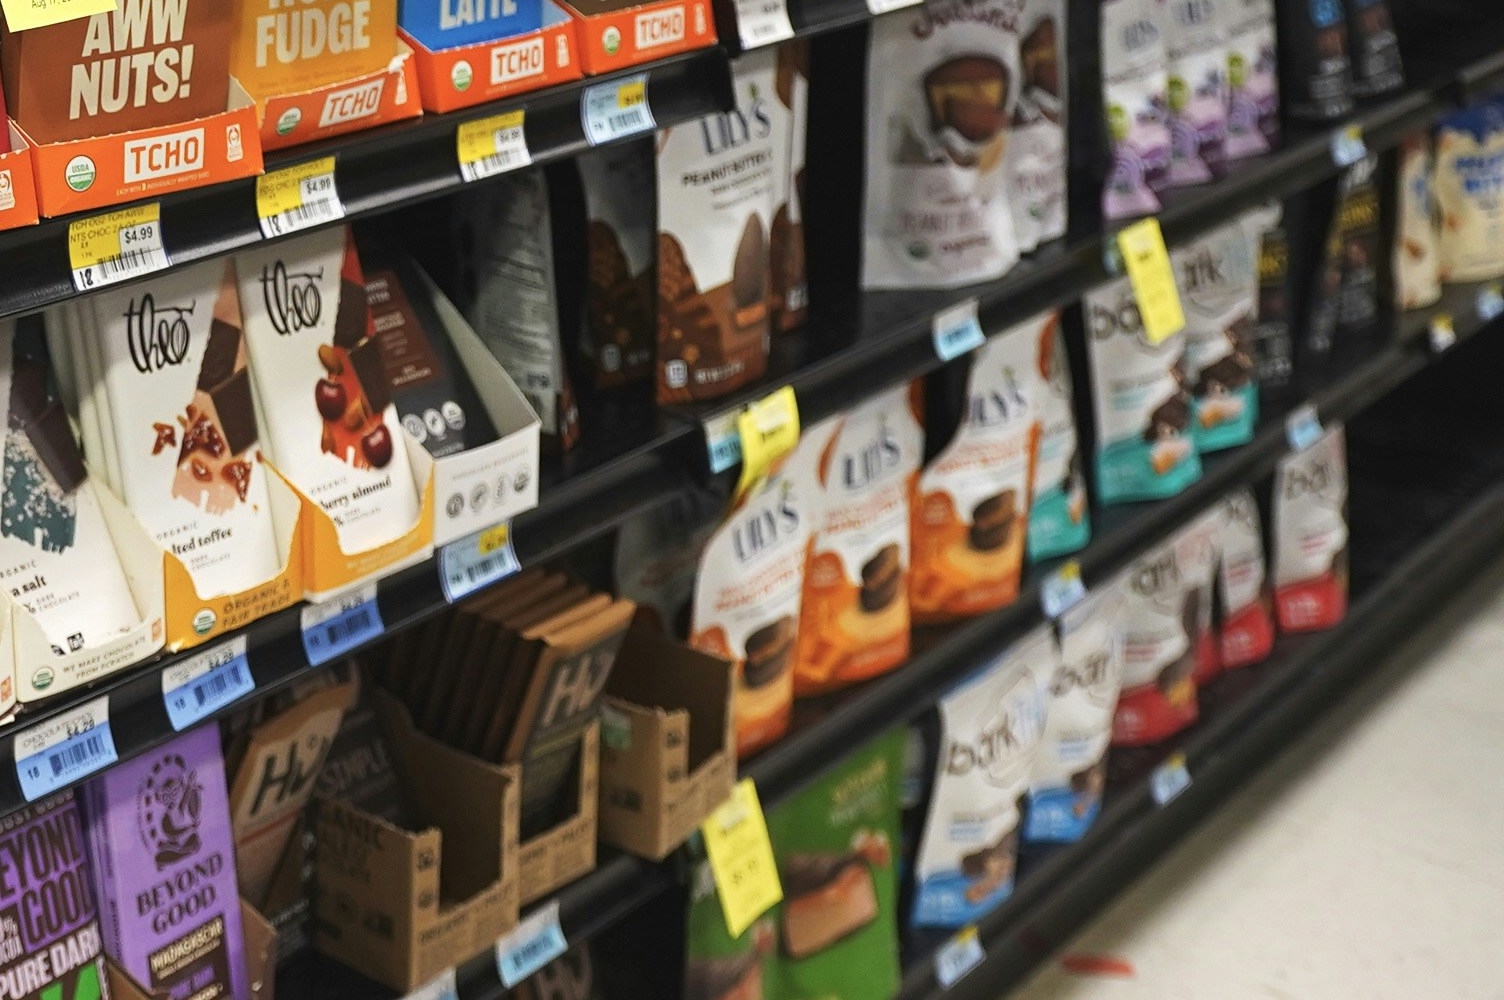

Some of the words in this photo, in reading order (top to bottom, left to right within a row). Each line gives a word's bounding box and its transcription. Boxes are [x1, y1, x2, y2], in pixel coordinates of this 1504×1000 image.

[256, 1, 371, 69] FUDGE
[640, 12, 684, 45] TCHO
[496, 44, 541, 79] TCHO
[69, 43, 194, 121] NUTS!
[130, 136, 199, 175] TCHO
[124, 227, 154, 245] $4.99
[124, 293, 195, 374] theo
[353, 475, 391, 502] almond
[197, 525, 233, 552] toffee
[136, 853, 223, 916] BEYOND
[151, 884, 216, 934] GOOD
